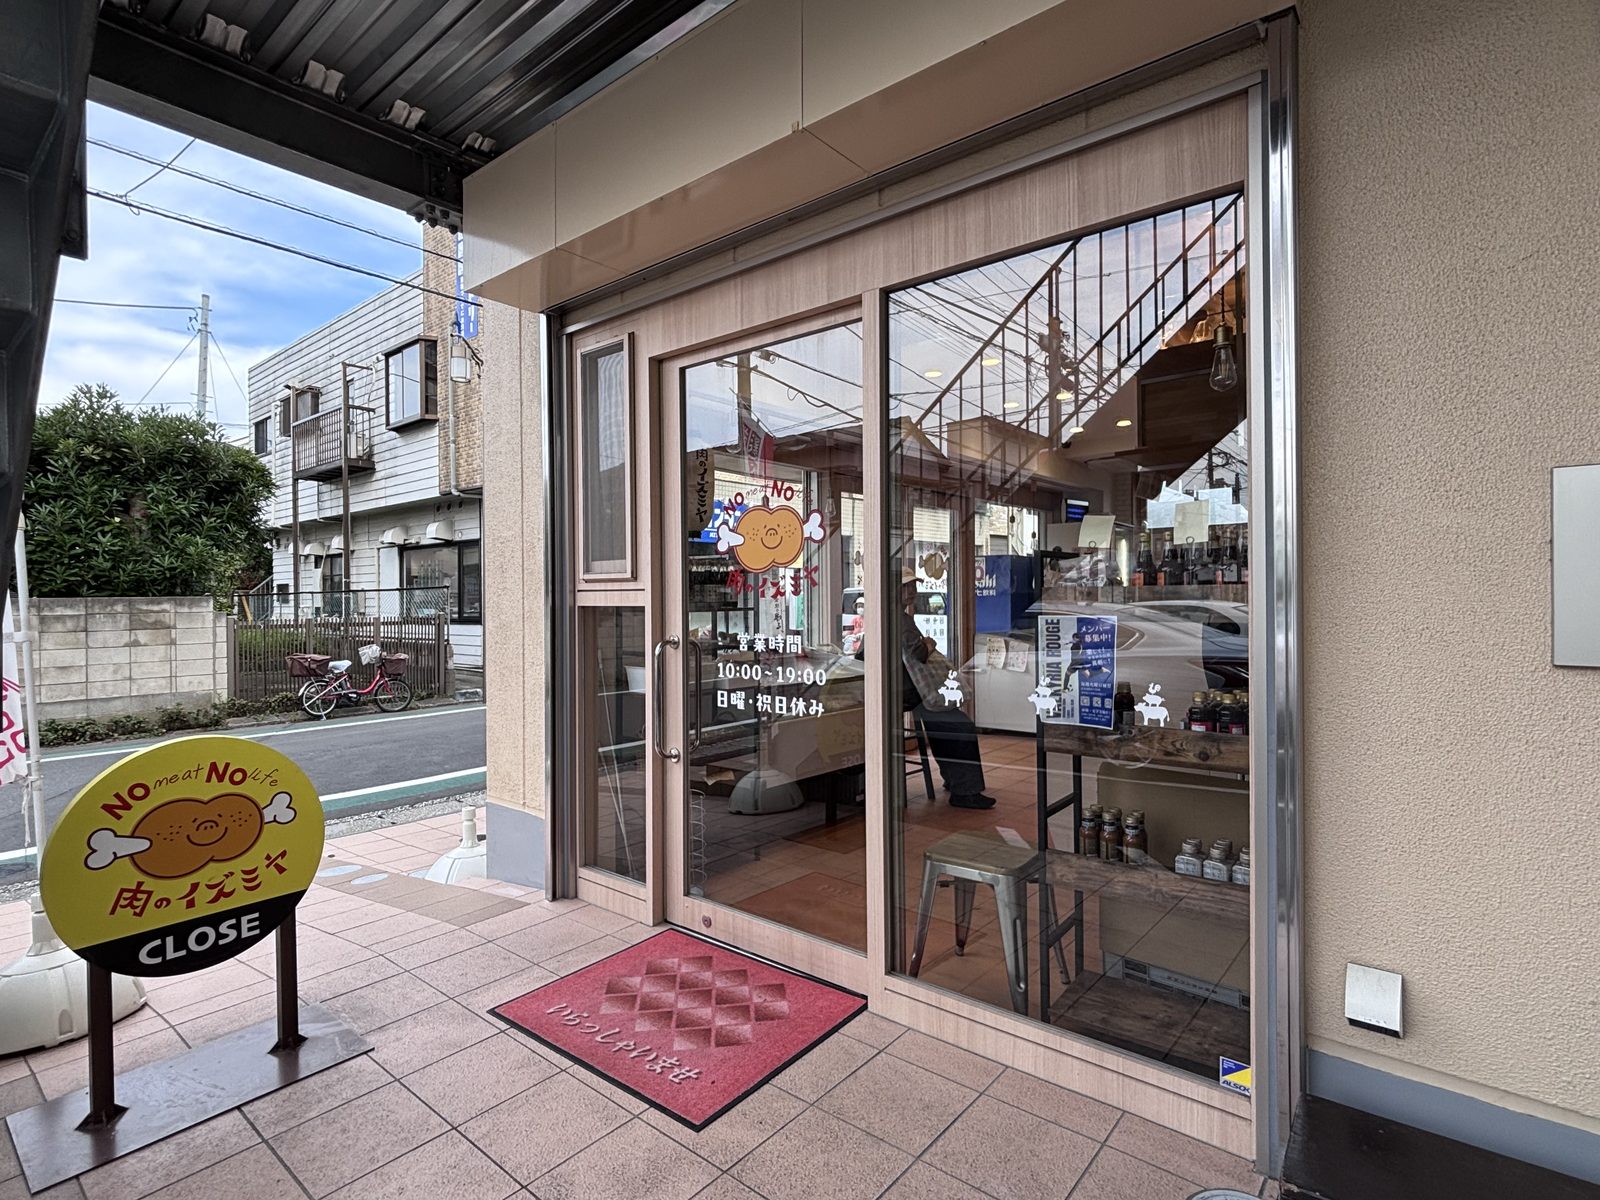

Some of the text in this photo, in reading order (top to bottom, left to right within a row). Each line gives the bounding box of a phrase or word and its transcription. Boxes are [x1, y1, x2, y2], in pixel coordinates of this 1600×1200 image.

[724, 492, 744, 518] NO
[736, 632, 802, 654] 営業時間
[1045, 618, 1061, 657] ROUGE
[1080, 625, 1111, 633] メンバー
[717, 690, 825, 718] 日曜・祝日休み
[100, 782, 151, 821] NO
[153, 763, 204, 791] meat
[247, 767, 279, 788] life
[109, 849, 288, 918] 肉のイズミヤ
[138, 912, 261, 966] CLOSE
[546, 1003, 702, 1084] いらっしゃいませ
